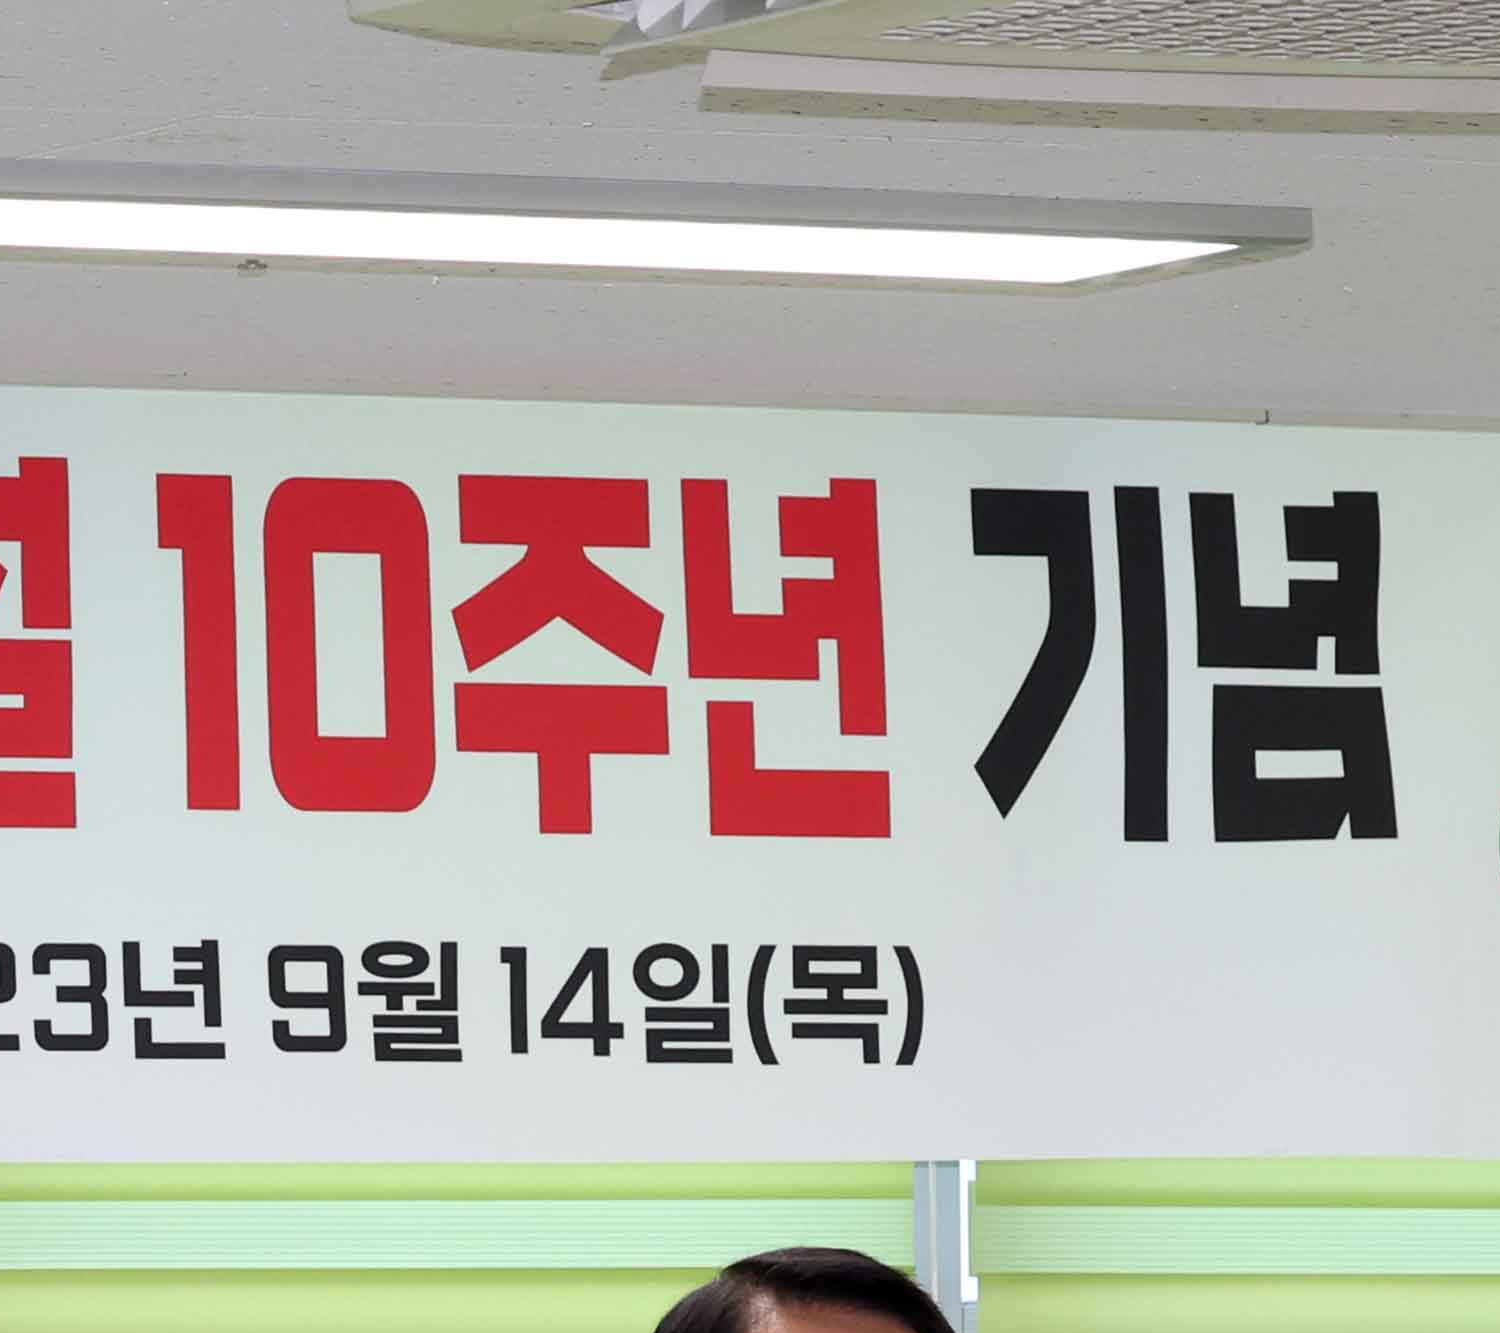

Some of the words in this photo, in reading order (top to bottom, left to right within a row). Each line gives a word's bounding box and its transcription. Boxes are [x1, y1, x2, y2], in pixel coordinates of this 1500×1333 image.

[156, 474, 892, 838] 10주년
[971, 484, 1398, 842] 기념
[268, 941, 462, 1062] 9월
[501, 943, 923, 1065] 14일(목)
